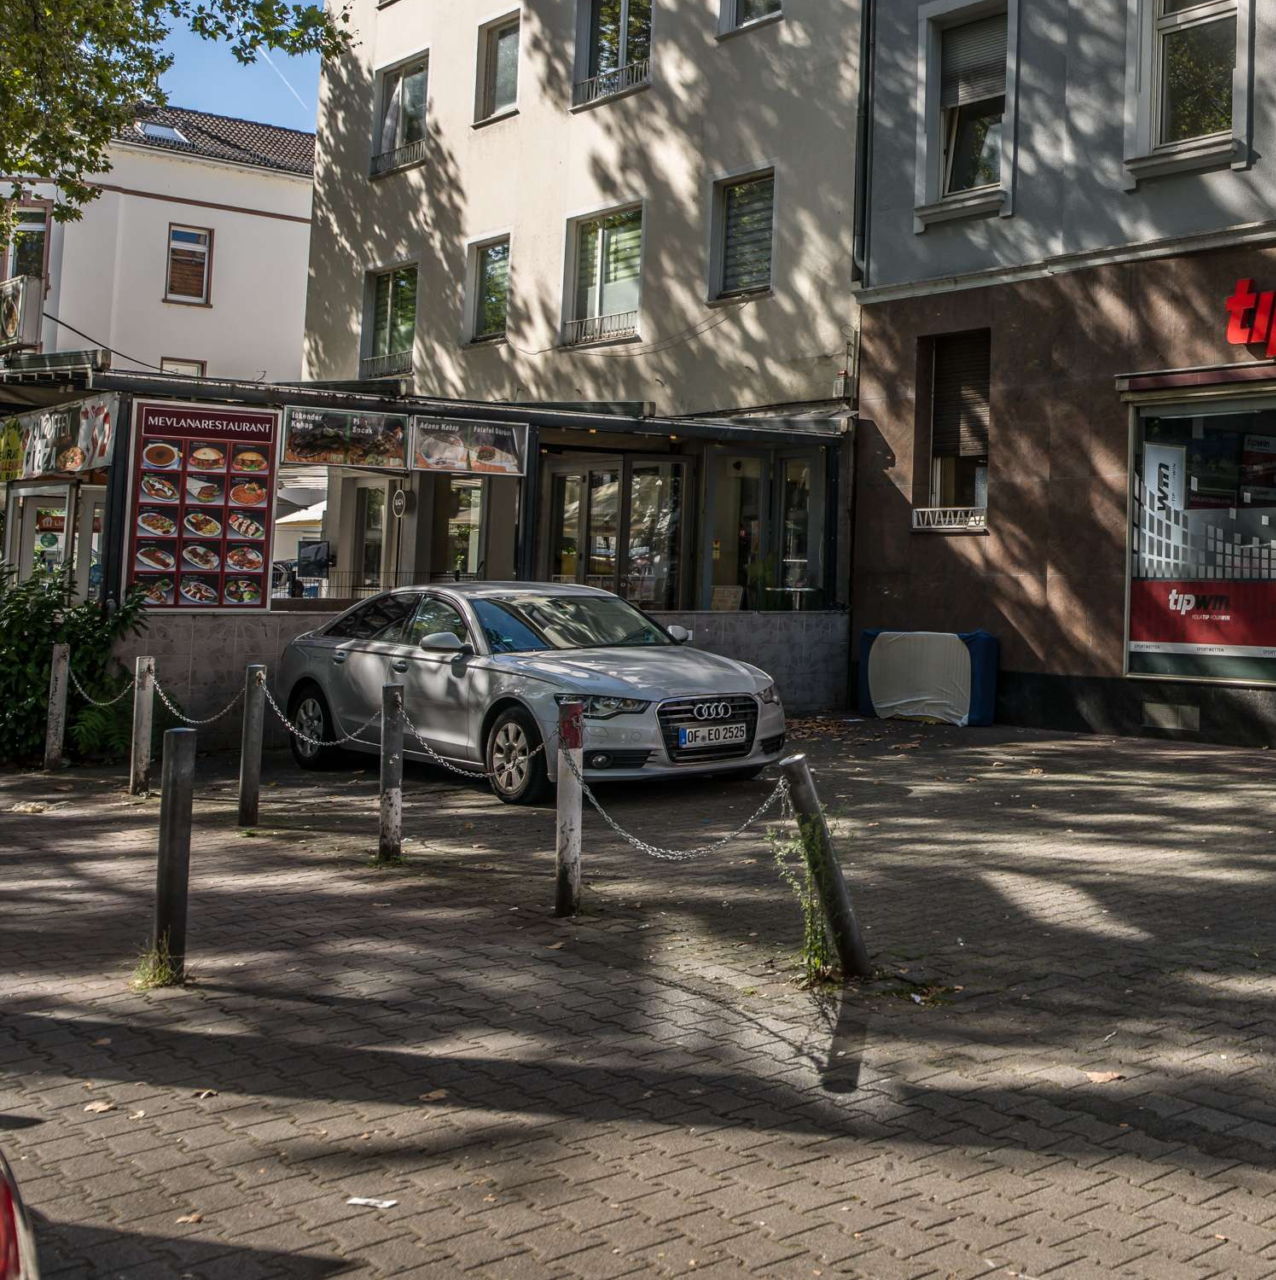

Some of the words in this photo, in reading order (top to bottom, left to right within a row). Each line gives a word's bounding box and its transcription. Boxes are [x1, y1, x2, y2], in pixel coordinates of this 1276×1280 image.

[148, 416, 271, 433] MEVLANARESTAURANT
[419, 422, 439, 430] Adana
[441, 423, 460, 432] Kebap
[1168, 588, 1230, 615] tipwin
[687, 730, 701, 744] OF
[722, 725, 745, 740] 2525
